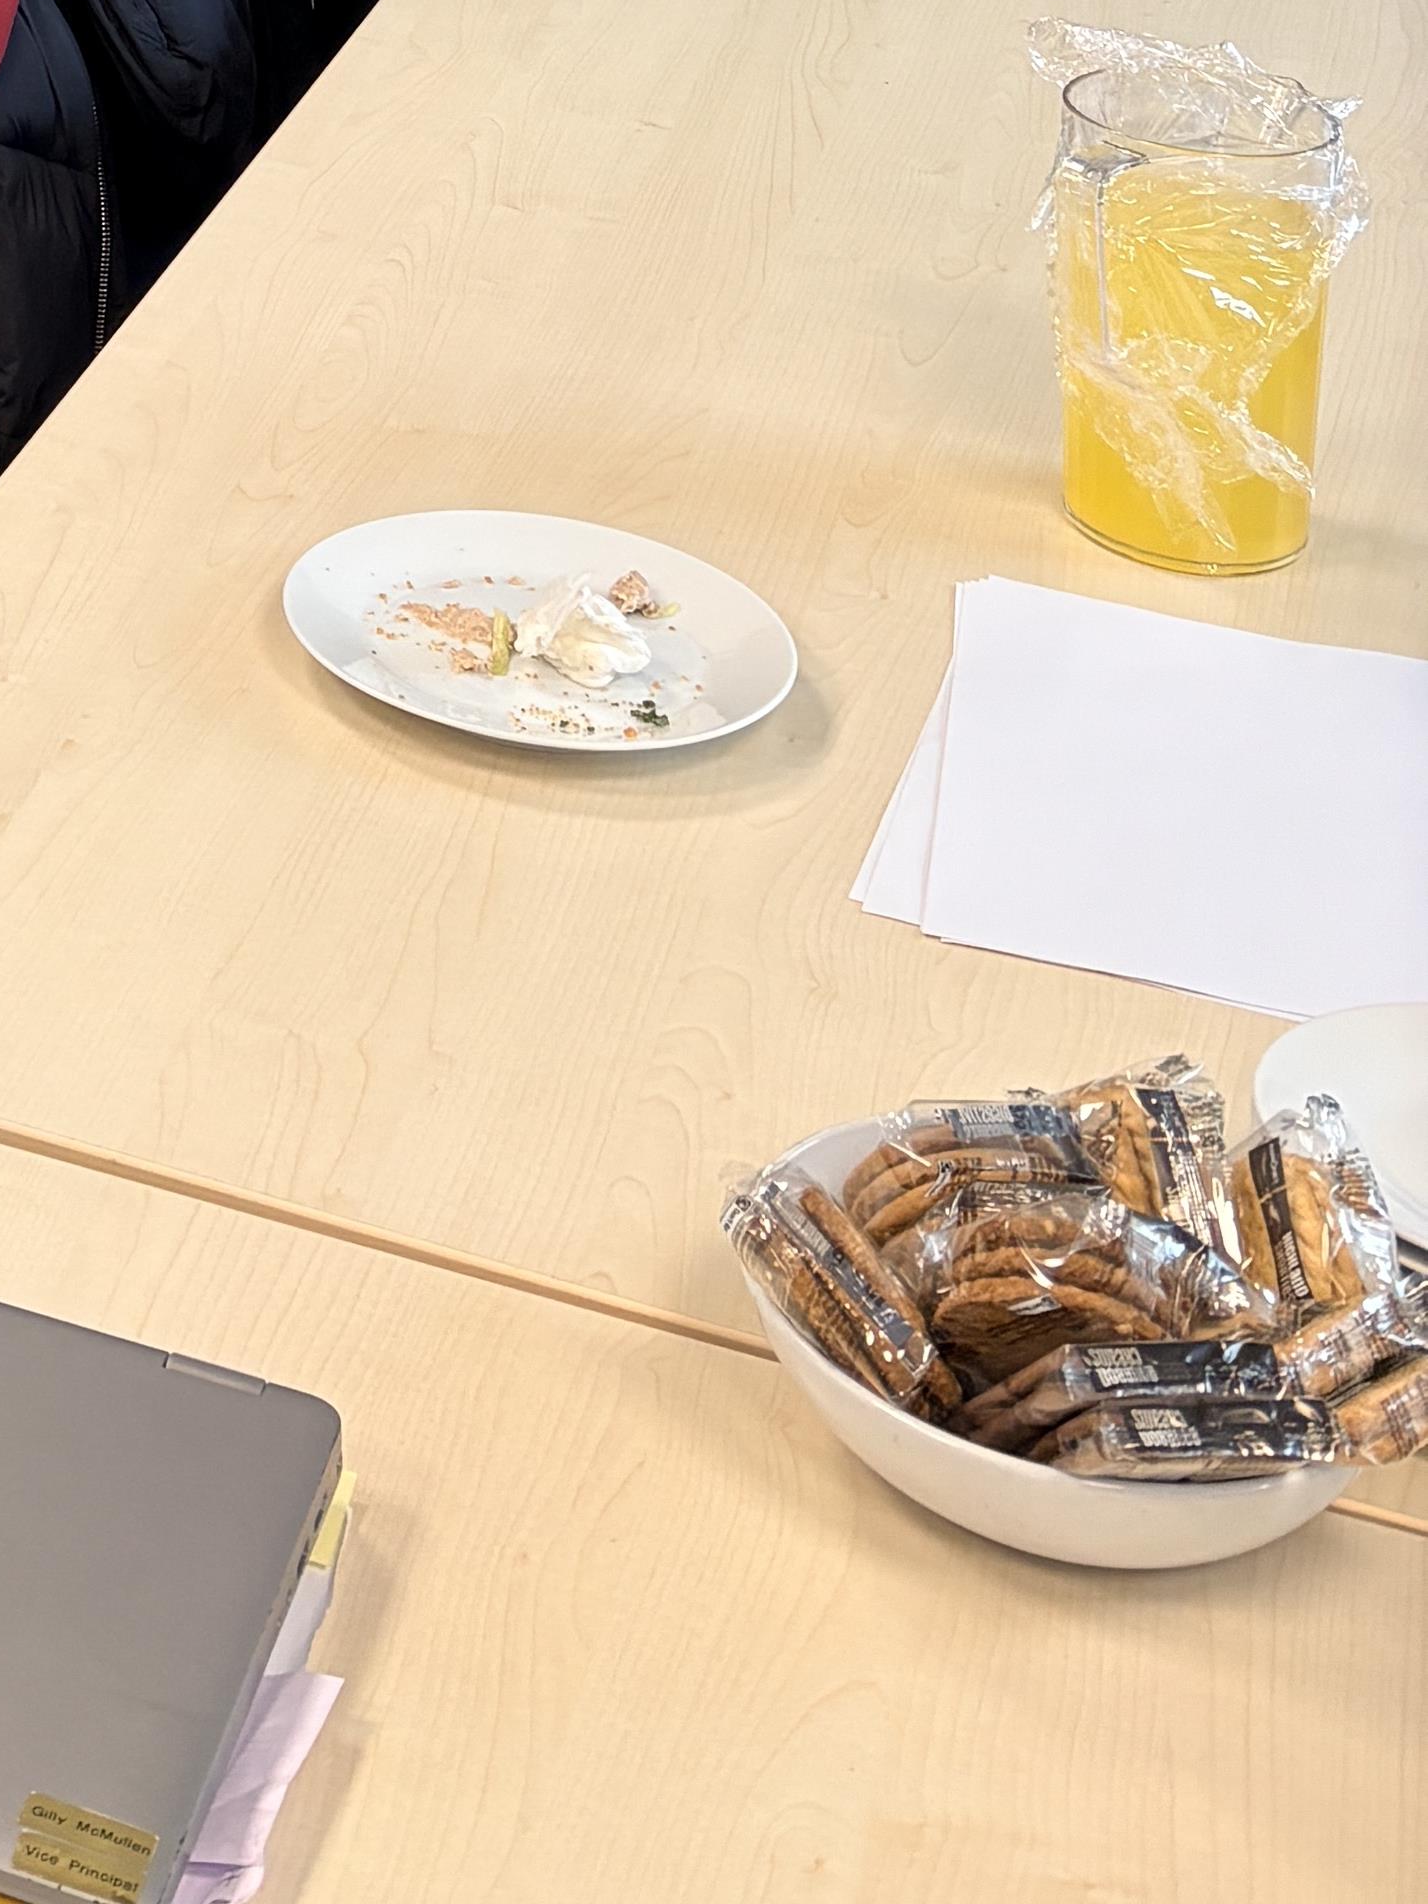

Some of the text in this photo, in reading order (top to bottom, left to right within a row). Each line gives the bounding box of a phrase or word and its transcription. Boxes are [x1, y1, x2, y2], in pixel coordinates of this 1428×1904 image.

[32, 1805, 151, 1857] Gilly McMullen
[25, 1844, 140, 1892] Vice Principal
